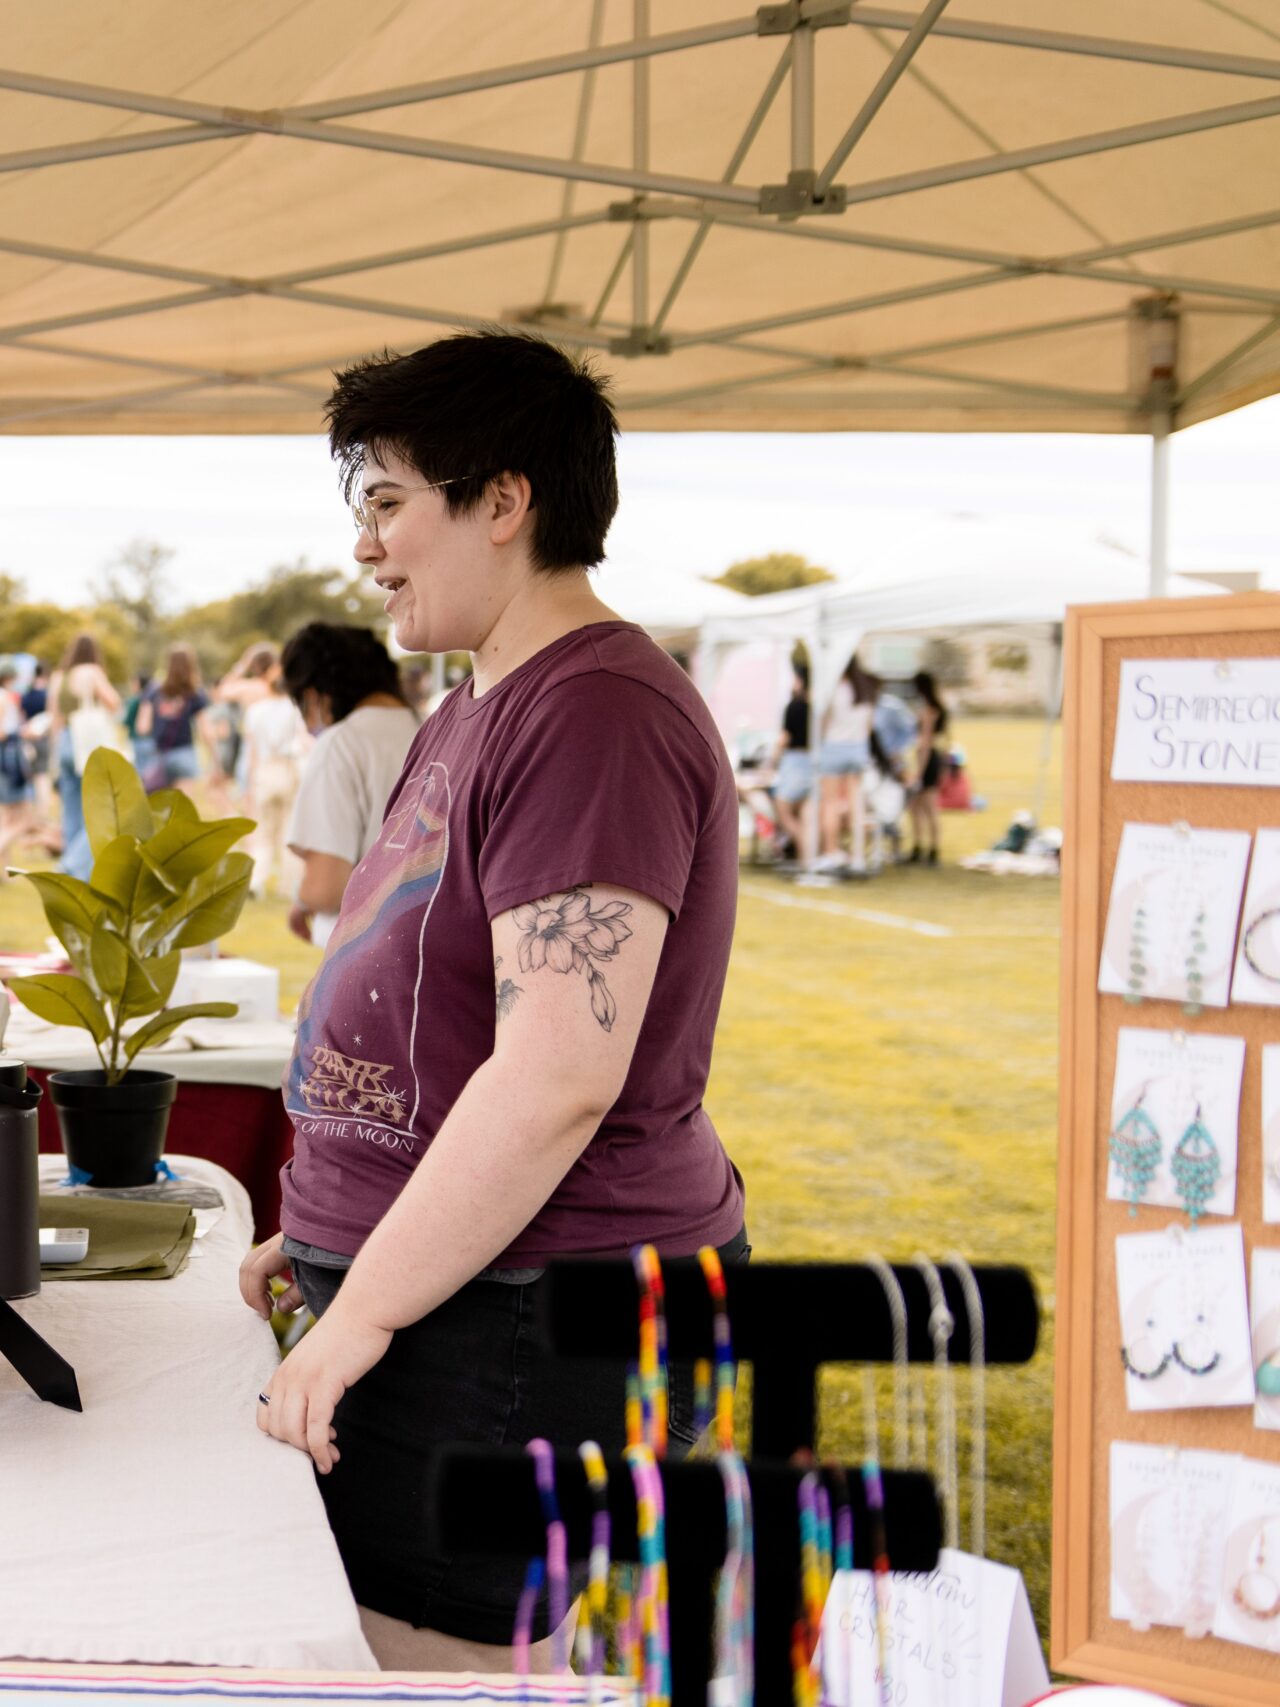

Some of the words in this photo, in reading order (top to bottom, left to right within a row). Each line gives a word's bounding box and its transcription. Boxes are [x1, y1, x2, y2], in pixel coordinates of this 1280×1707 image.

[301, 1120, 323, 1136] OF
[322, 1121, 353, 1139] THE
[355, 1124, 415, 1153] MOON
